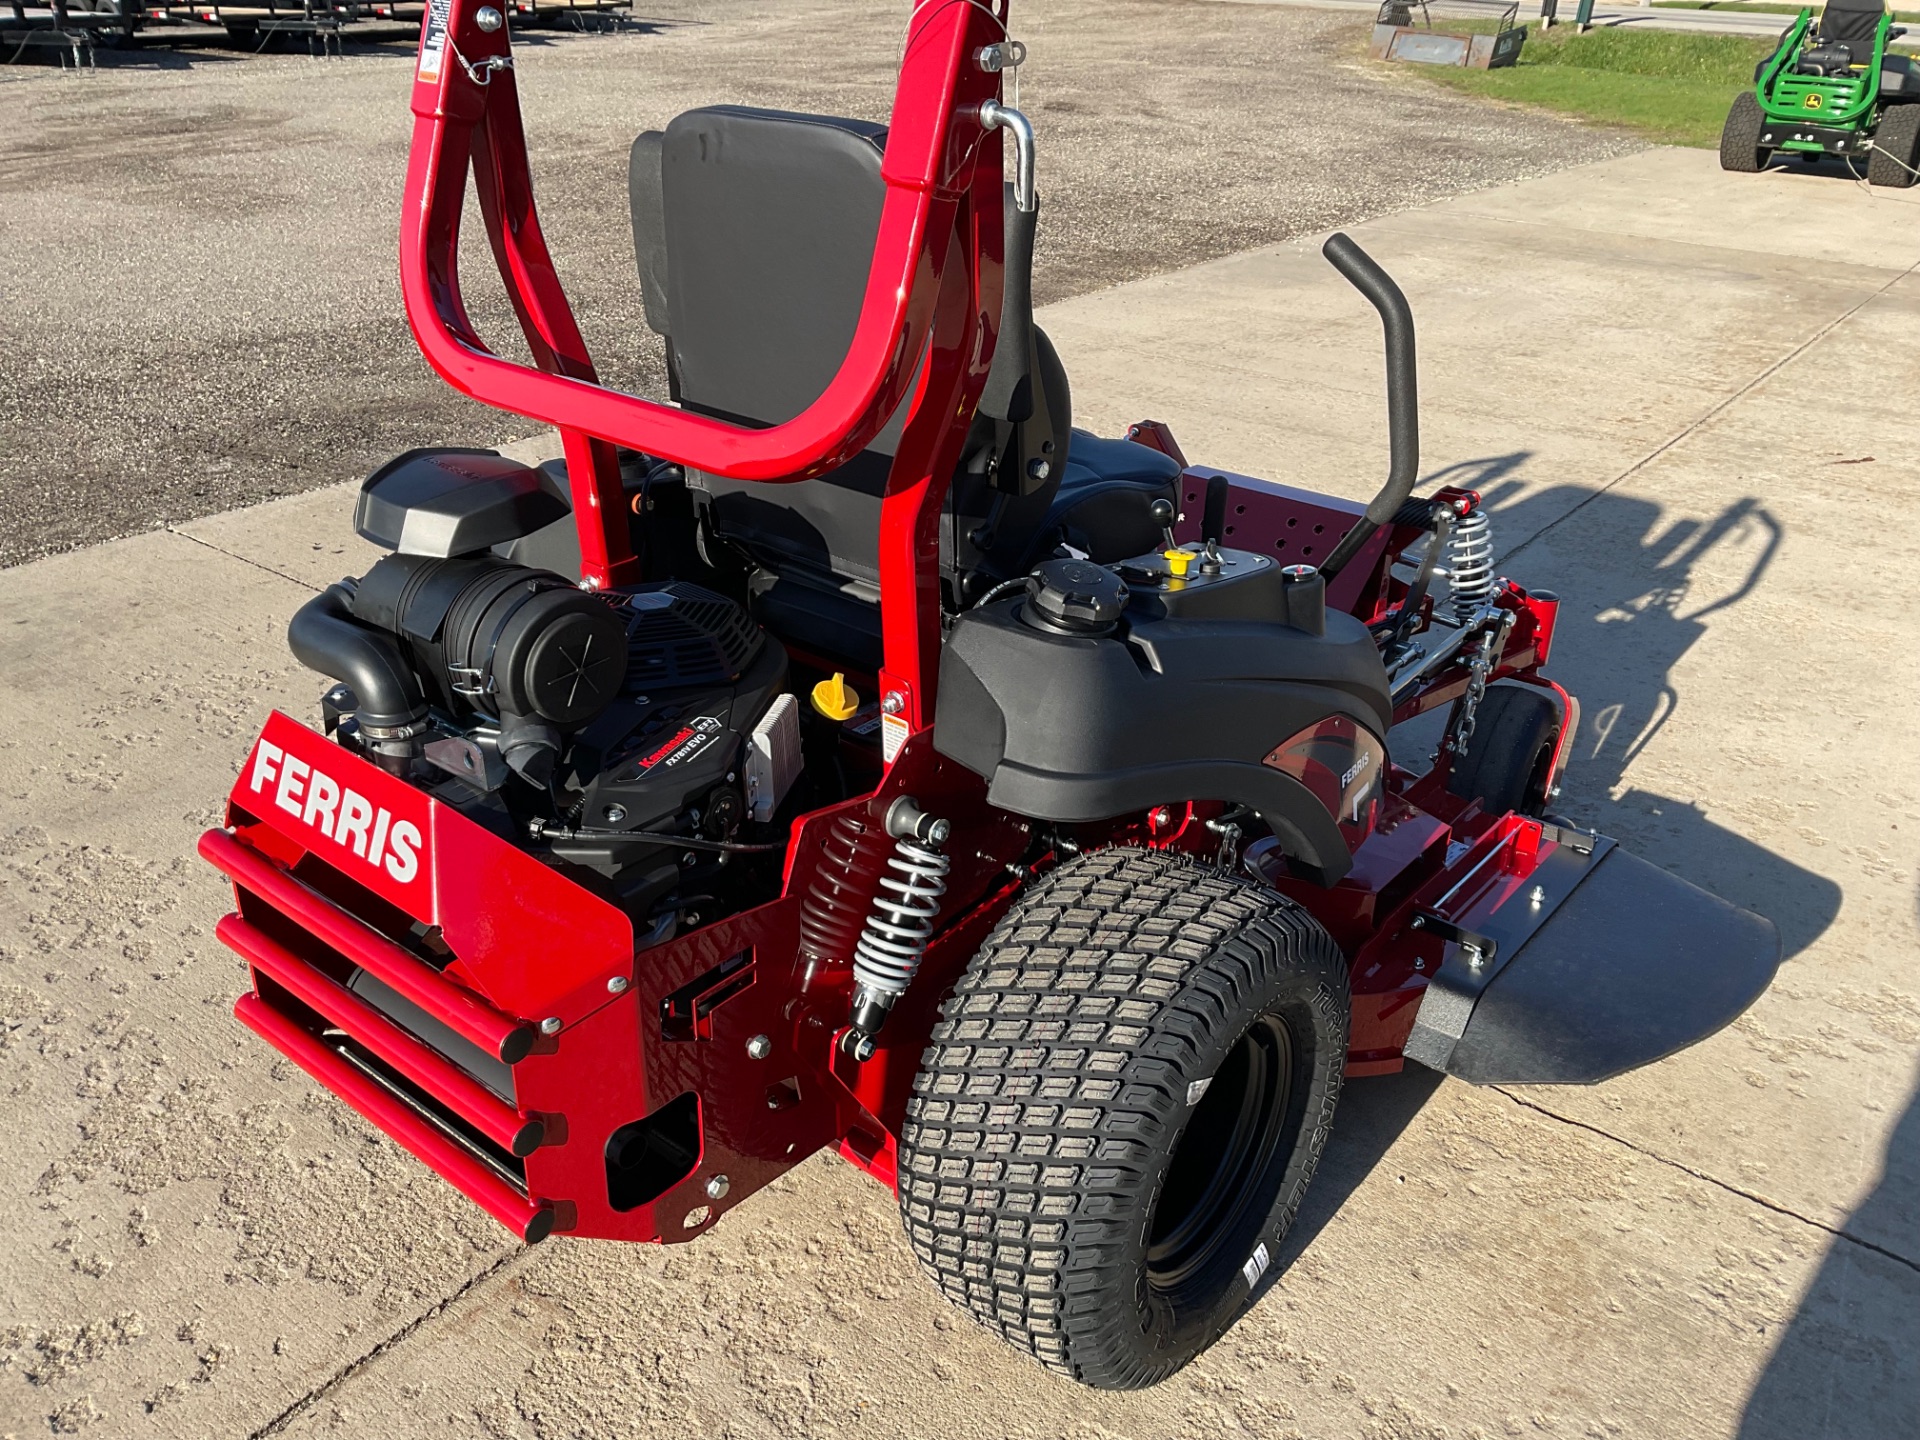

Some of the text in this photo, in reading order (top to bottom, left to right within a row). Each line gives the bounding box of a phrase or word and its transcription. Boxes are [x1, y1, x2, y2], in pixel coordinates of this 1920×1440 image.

[687, 733, 707, 749] EVO
[698, 719, 713, 731] EFI
[638, 727, 695, 769] Kawasaki
[1341, 751, 1369, 789] FERRIS
[250, 738, 422, 883] FERRIS
[1272, 981, 1344, 1243] TURF MASTER
